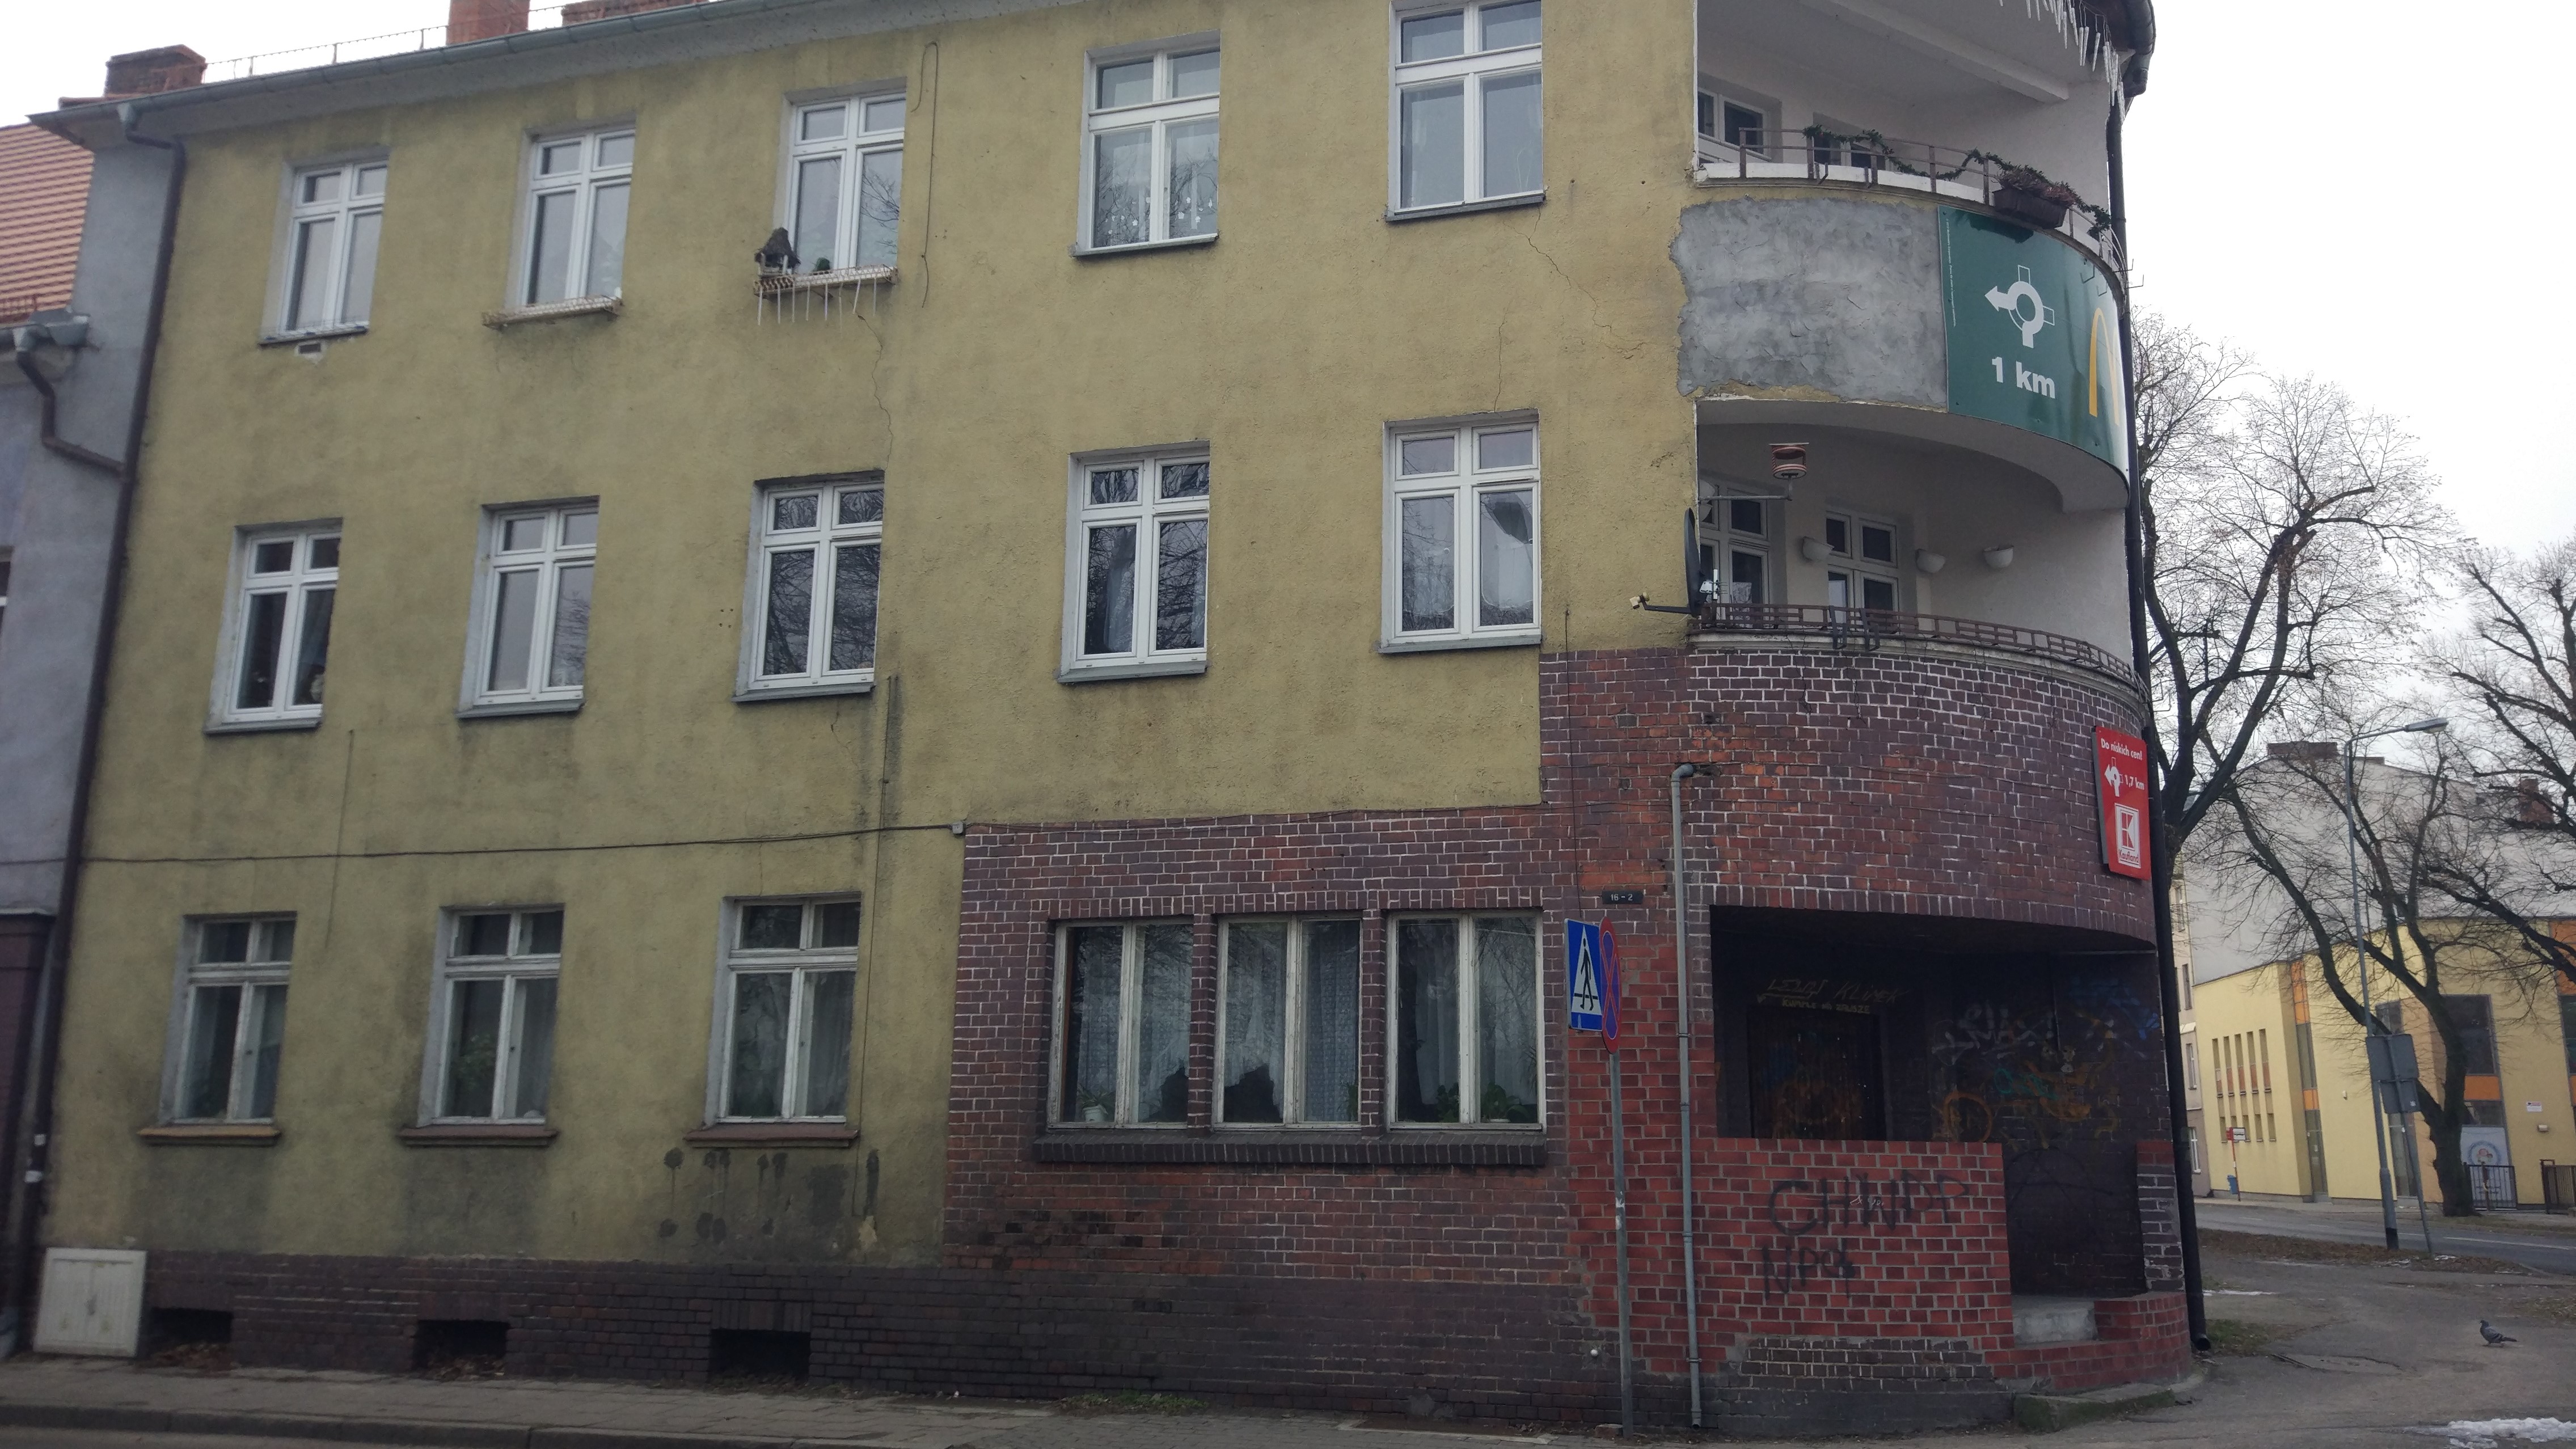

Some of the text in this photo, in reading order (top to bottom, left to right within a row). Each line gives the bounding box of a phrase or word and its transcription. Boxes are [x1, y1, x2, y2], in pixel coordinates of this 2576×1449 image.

[1992, 357, 2055, 399] 1 km
[2101, 738, 2143, 761] Do niskich cen!
[2125, 775, 2144, 790] 1,7 km
[2118, 849, 2139, 863] Kaufland
